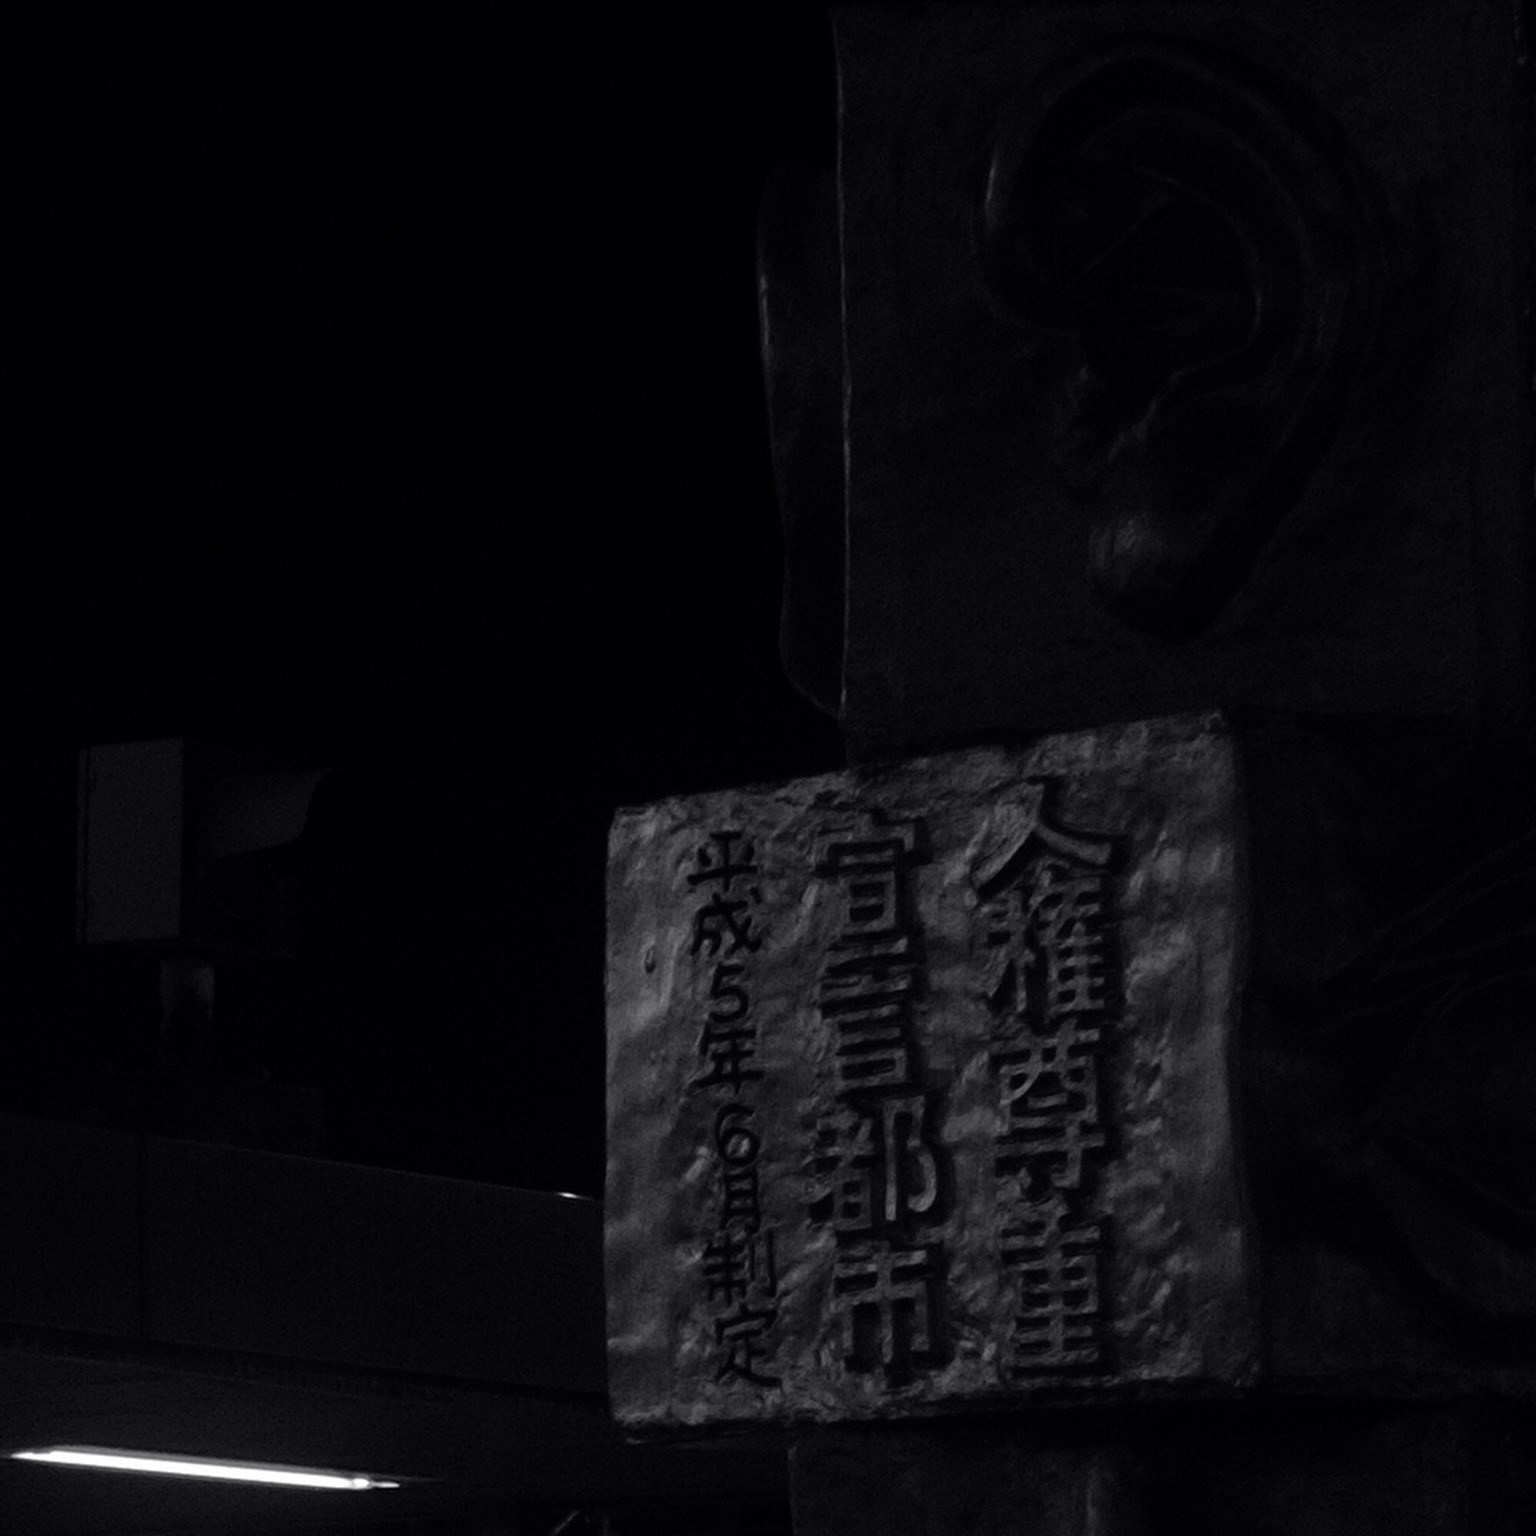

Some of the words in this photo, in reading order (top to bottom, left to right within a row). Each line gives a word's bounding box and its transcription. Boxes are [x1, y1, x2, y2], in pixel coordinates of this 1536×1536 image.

[686, 830, 782, 1388] 平成5年6月制定
[809, 805, 950, 1390] 宣言都市
[976, 775, 1132, 1382] 人権尊重
